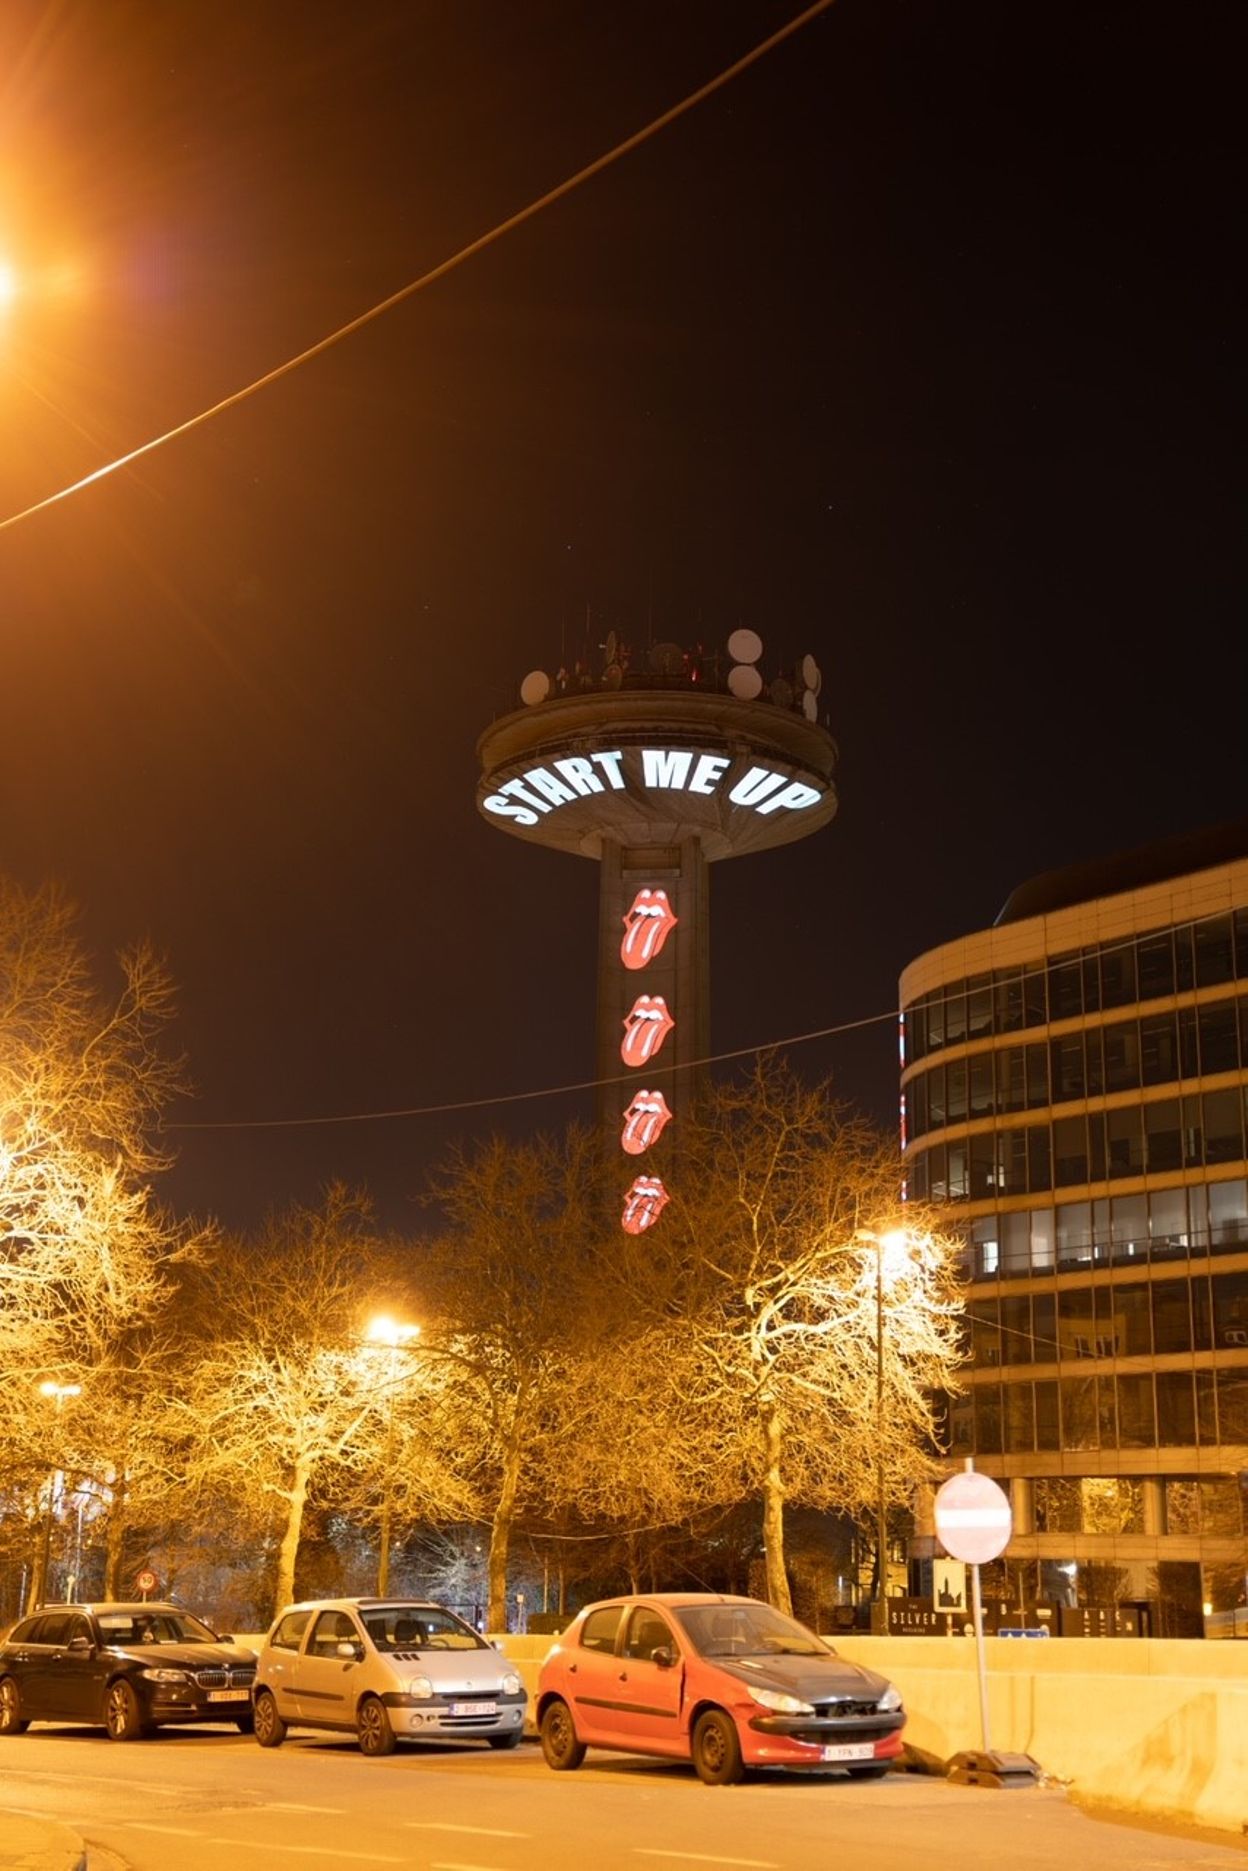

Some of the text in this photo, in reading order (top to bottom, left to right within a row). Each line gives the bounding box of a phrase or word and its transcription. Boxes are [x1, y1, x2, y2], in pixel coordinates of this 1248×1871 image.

[483, 749, 822, 825] START ME UP
[892, 1611, 937, 1626] SILVER
